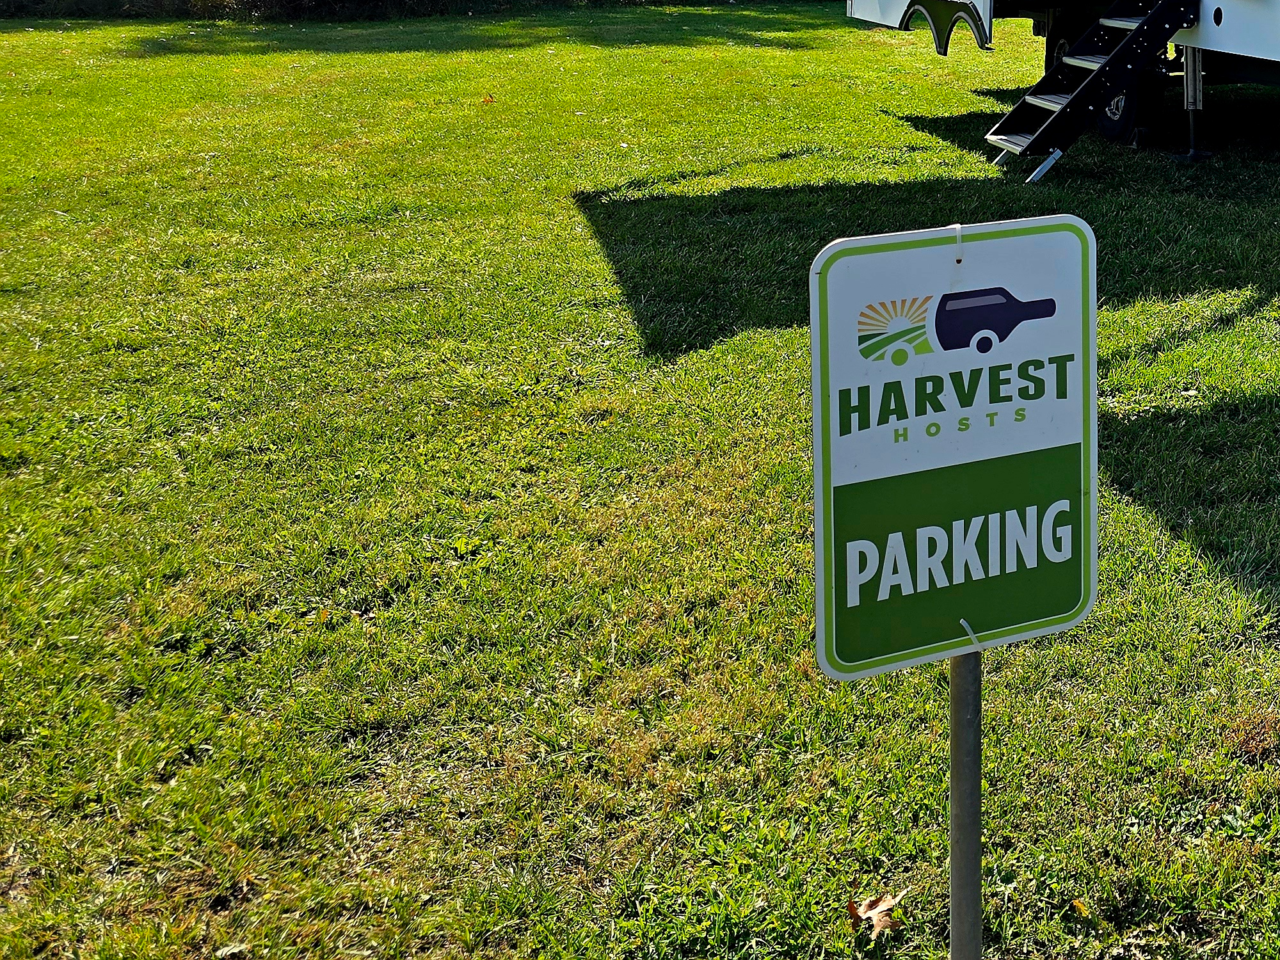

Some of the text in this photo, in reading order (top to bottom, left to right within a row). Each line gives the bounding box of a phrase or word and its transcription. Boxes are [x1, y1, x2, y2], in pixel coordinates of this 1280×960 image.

[838, 353, 1076, 437] HARVEST
[893, 407, 1028, 444] HOSTS
[845, 499, 1073, 609] PARKING
